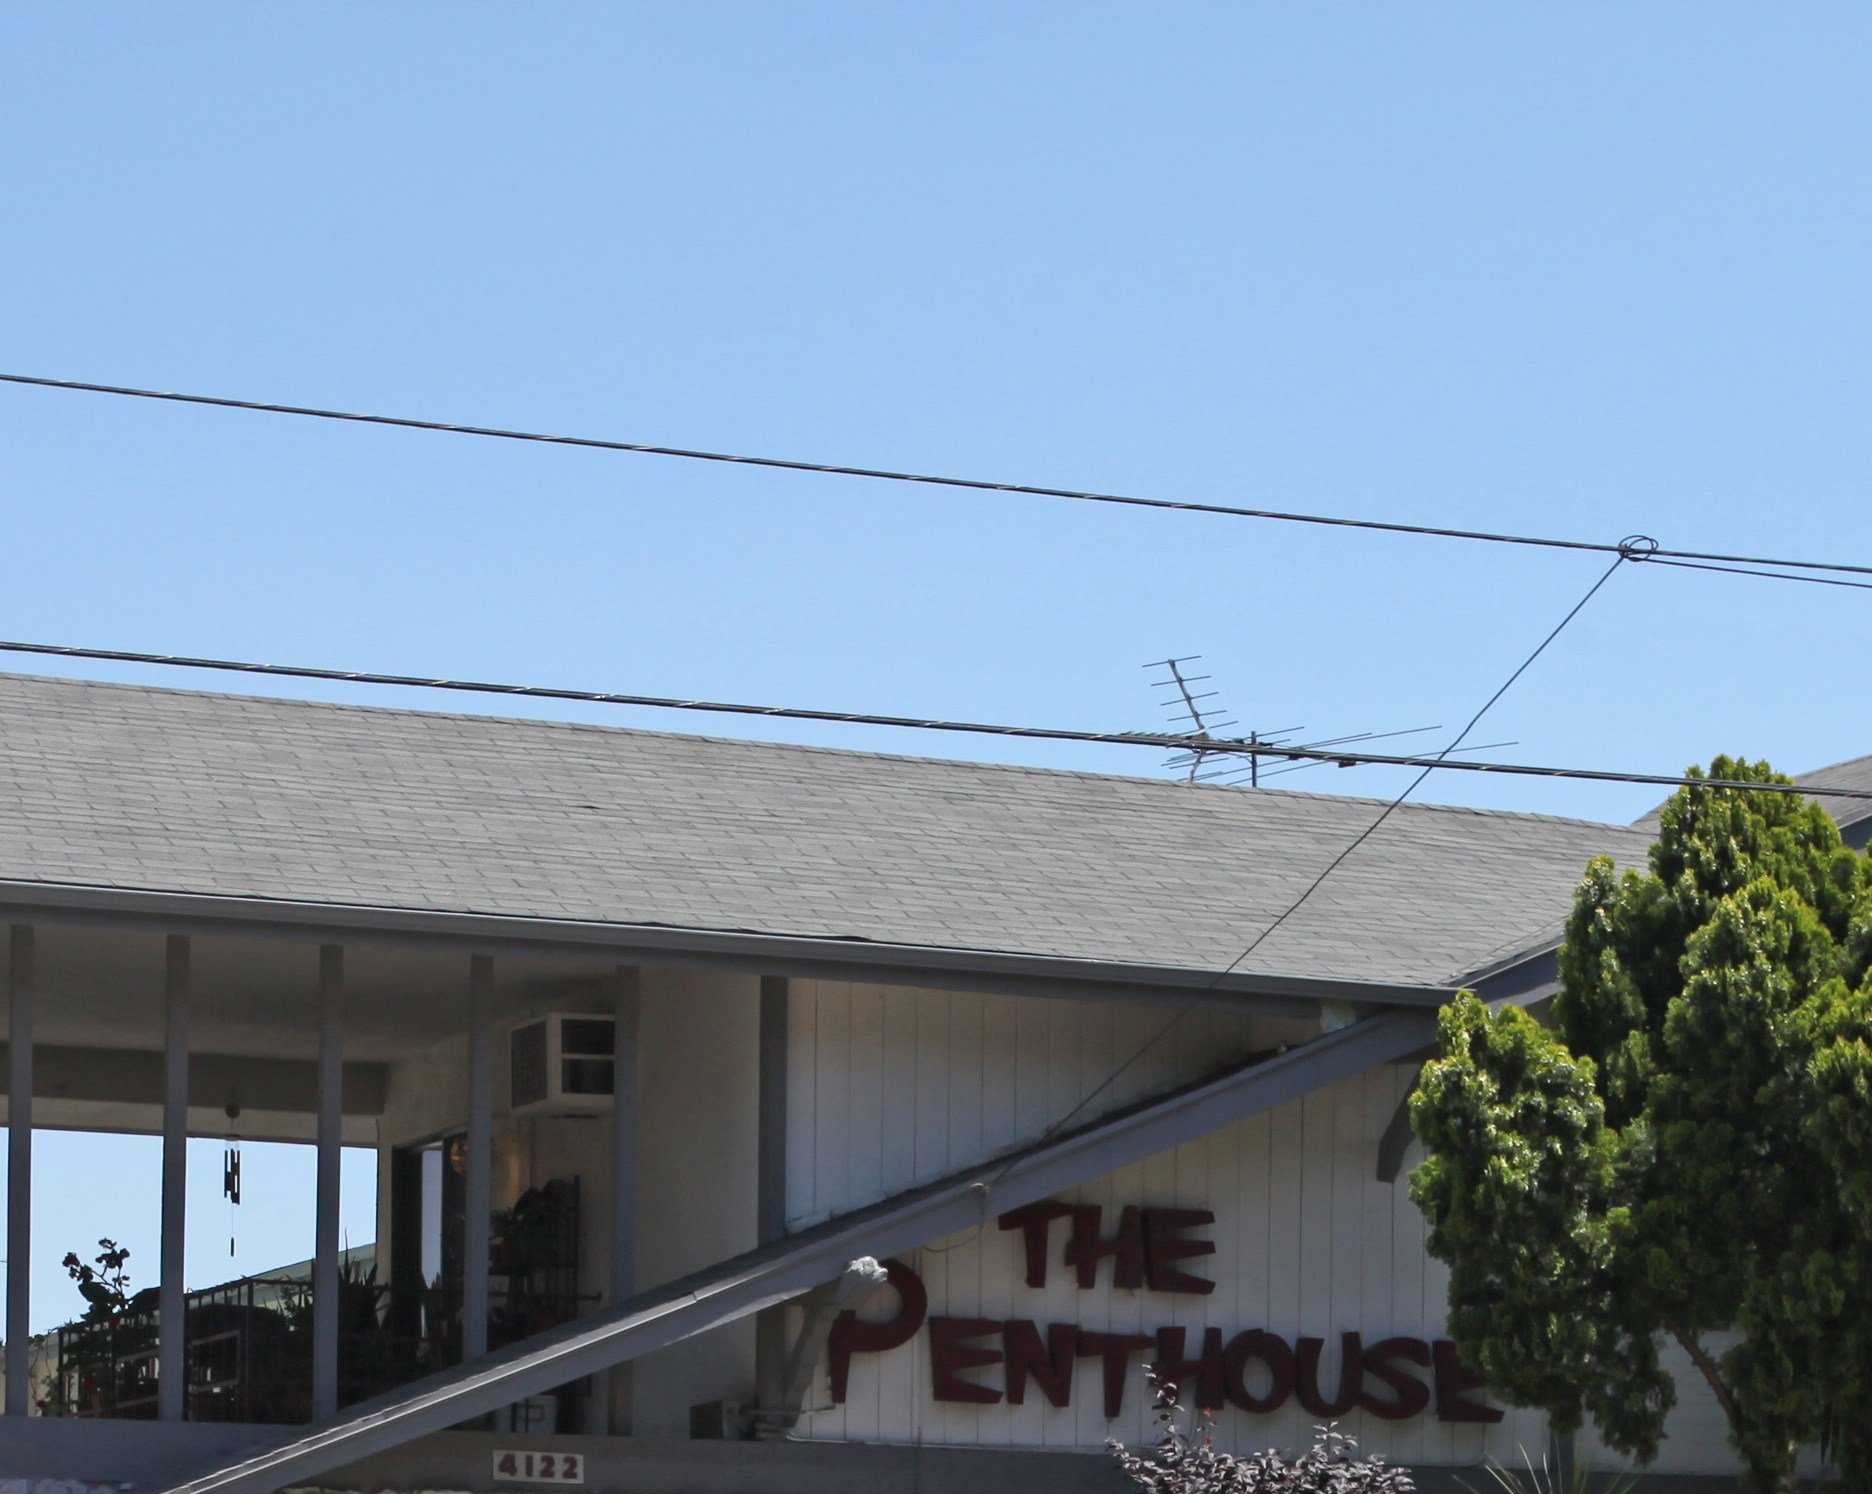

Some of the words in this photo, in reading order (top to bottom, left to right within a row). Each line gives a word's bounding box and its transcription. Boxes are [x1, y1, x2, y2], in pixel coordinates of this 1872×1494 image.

[998, 1203, 1216, 1295] THE
[829, 1258, 1505, 1422] PENTHOUSE
[497, 1453, 578, 1479] 4122
